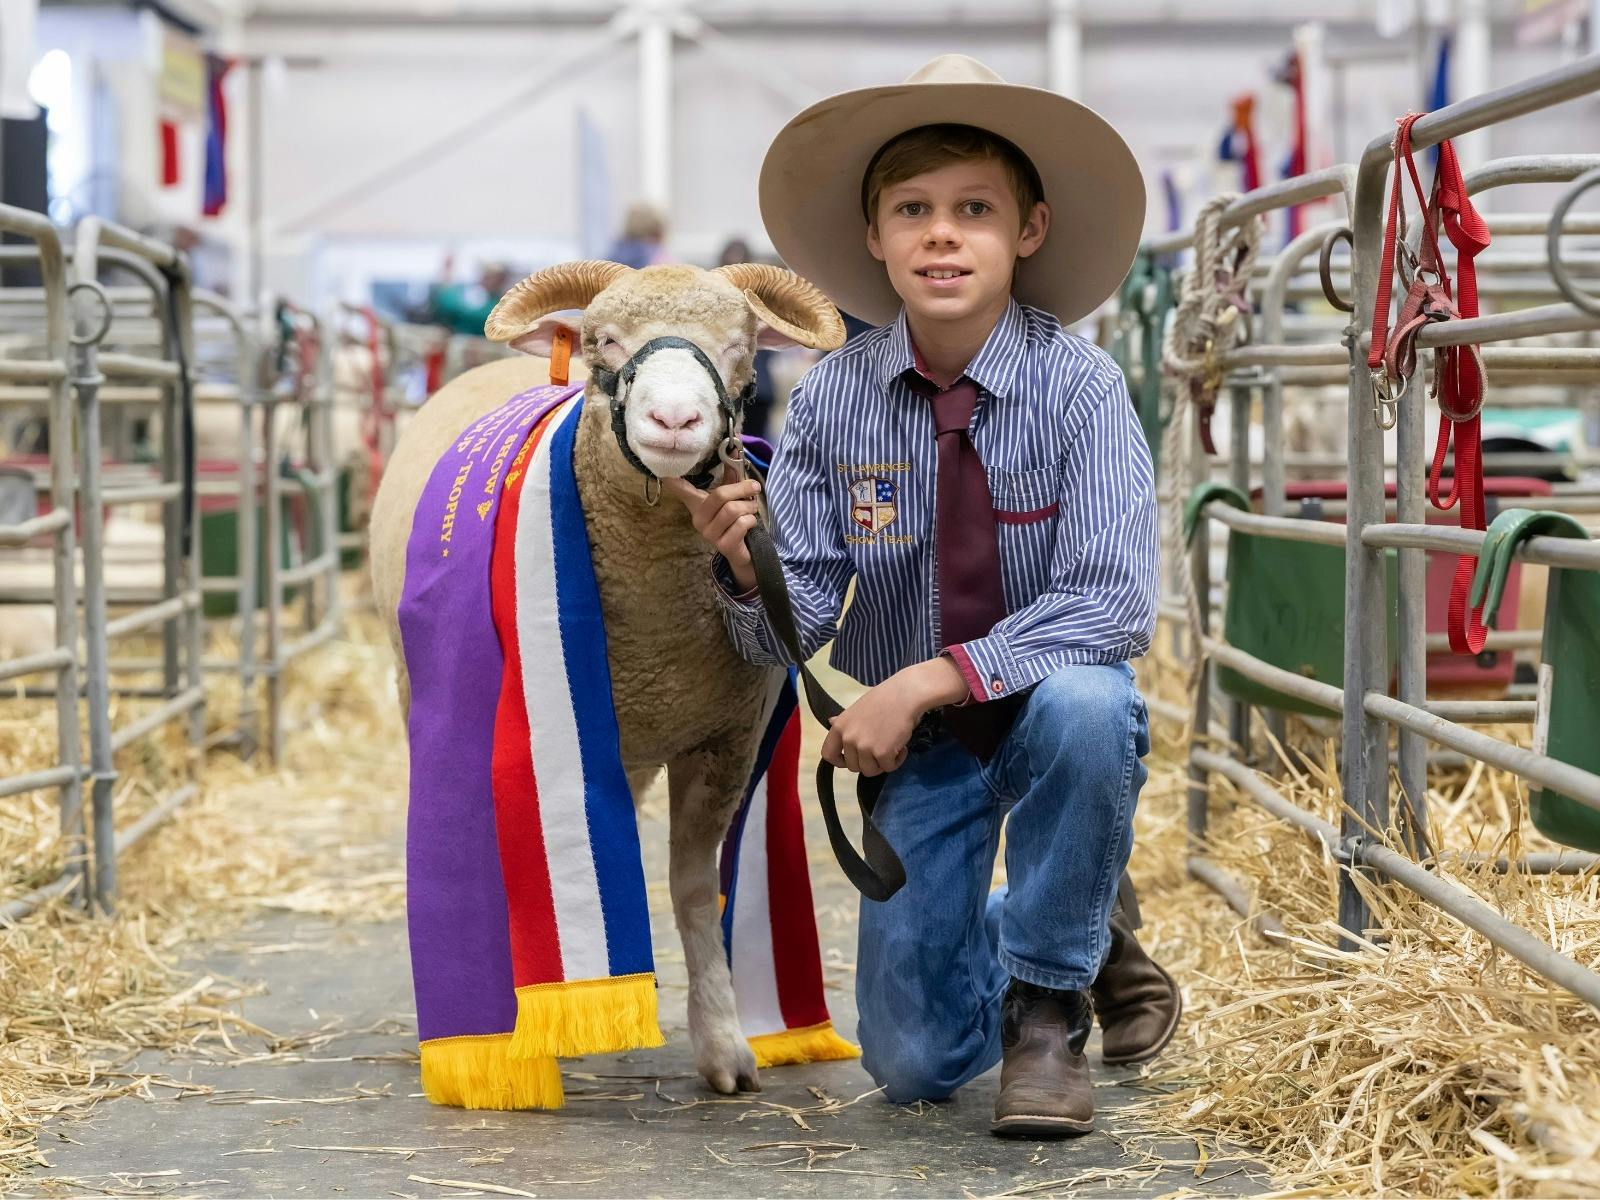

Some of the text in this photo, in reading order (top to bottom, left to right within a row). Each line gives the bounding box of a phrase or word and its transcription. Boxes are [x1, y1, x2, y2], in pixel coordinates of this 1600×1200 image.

[484, 433, 519, 495] SHOW
[853, 462, 912, 473] LAWRENCES
[441, 460, 474, 543] TROPHY
[845, 534, 914, 545] SHOW TEAM
